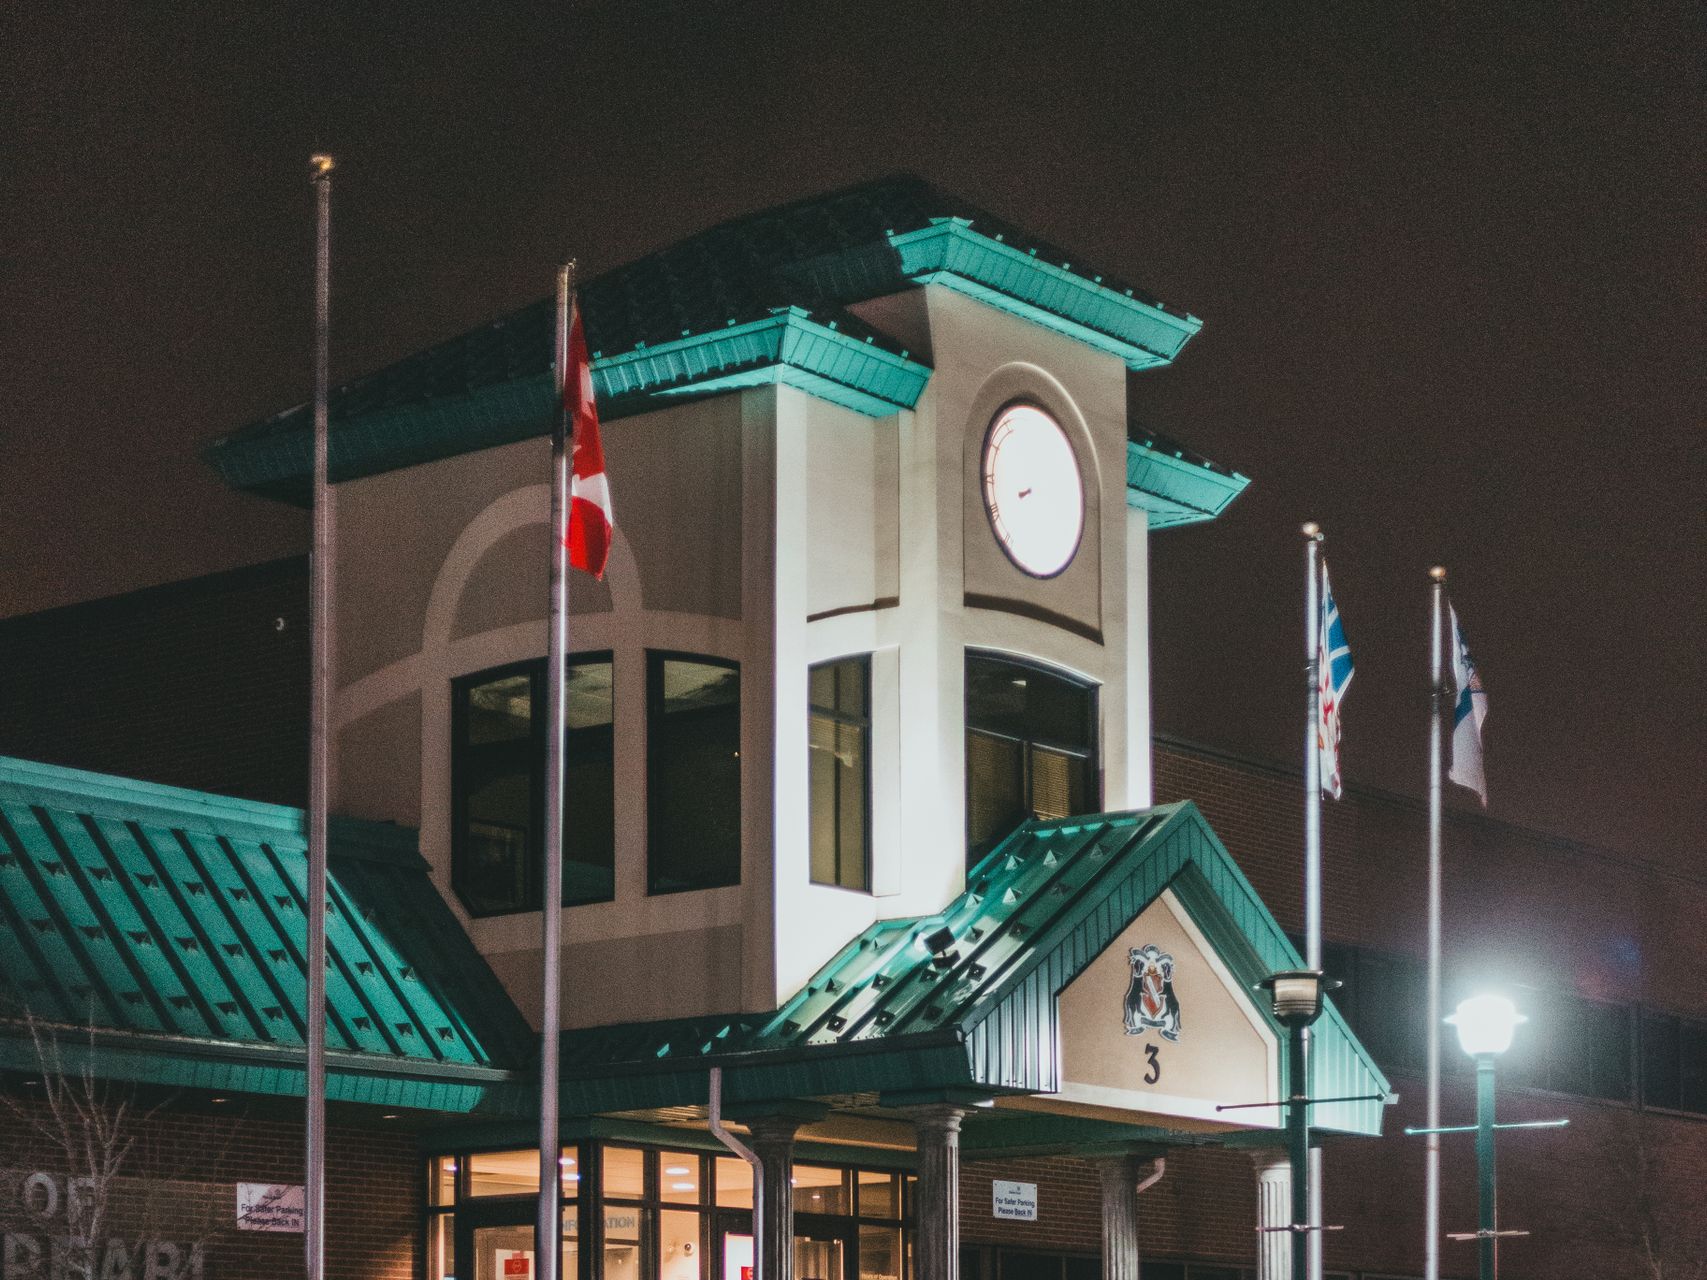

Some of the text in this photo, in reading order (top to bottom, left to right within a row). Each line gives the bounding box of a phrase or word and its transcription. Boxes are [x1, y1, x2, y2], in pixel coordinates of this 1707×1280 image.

[1144, 1043, 1161, 1085] 3
[23, 1172, 100, 1224] OF
[1004, 1197, 1016, 1205] Safer
[1017, 1199, 1035, 1208] Parking
[241, 1203, 253, 1212] For
[276, 1205, 303, 1217] Parking
[998, 1207, 1014, 1215] Please
[292, 1218, 299, 1226] IN
